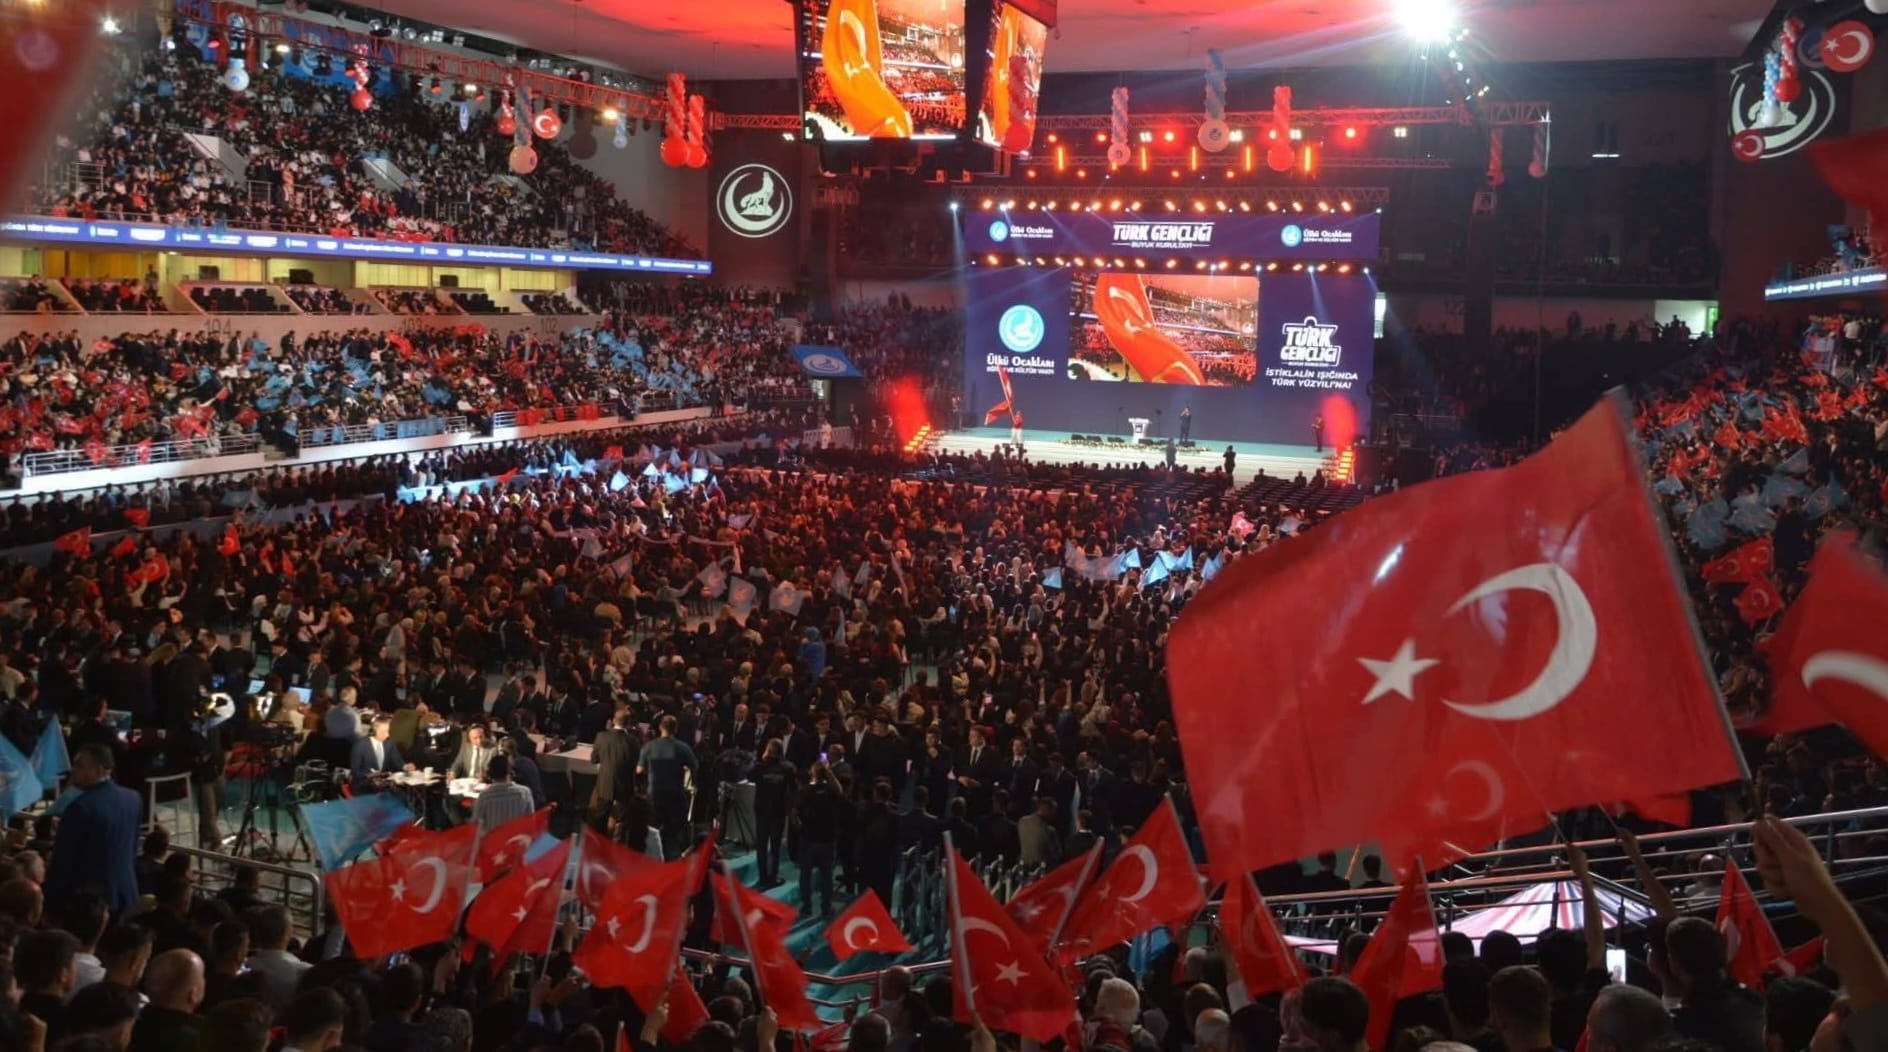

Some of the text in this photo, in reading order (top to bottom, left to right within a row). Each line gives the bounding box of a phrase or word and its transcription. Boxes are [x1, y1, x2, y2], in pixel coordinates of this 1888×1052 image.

[1265, 368, 1358, 380] İSTİKLALİN IŞIĞINDA
[1271, 378, 1295, 387] TÜRK
